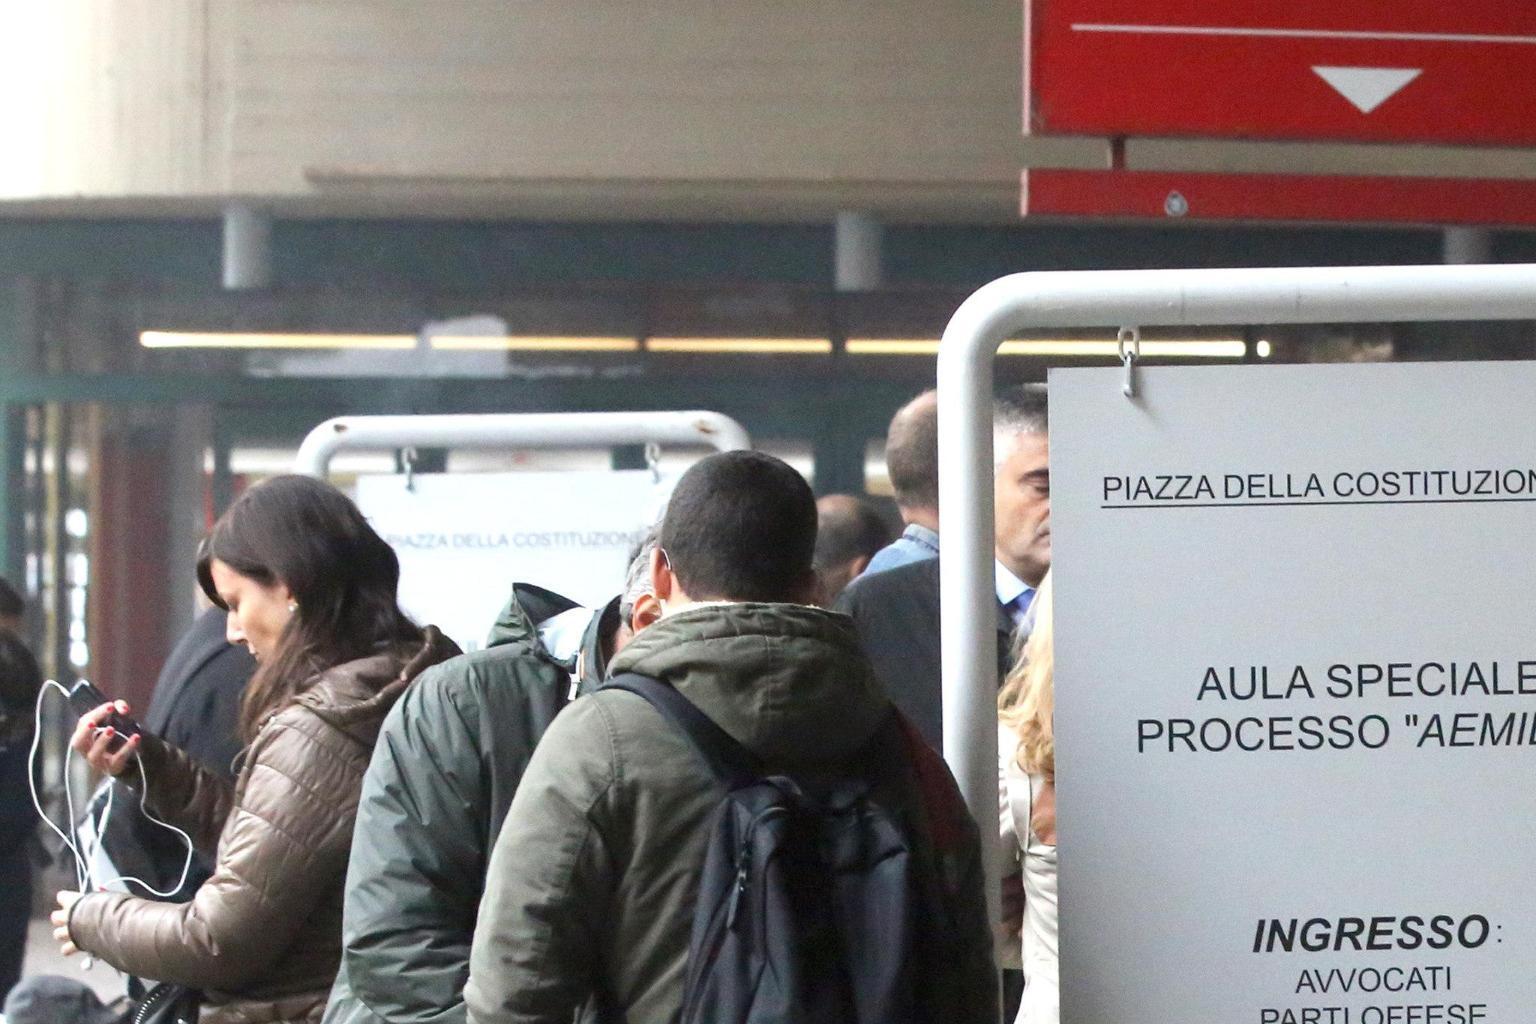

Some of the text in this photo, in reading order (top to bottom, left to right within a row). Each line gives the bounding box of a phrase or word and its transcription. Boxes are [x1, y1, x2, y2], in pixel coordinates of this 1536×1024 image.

[1103, 475, 1216, 501] PIAZZA
[1224, 473, 1325, 499] DELLA
[1196, 665, 1315, 701] AULA
[1137, 714, 1390, 754] PROCESSO
[1295, 966, 1452, 994] AVVOCATI
